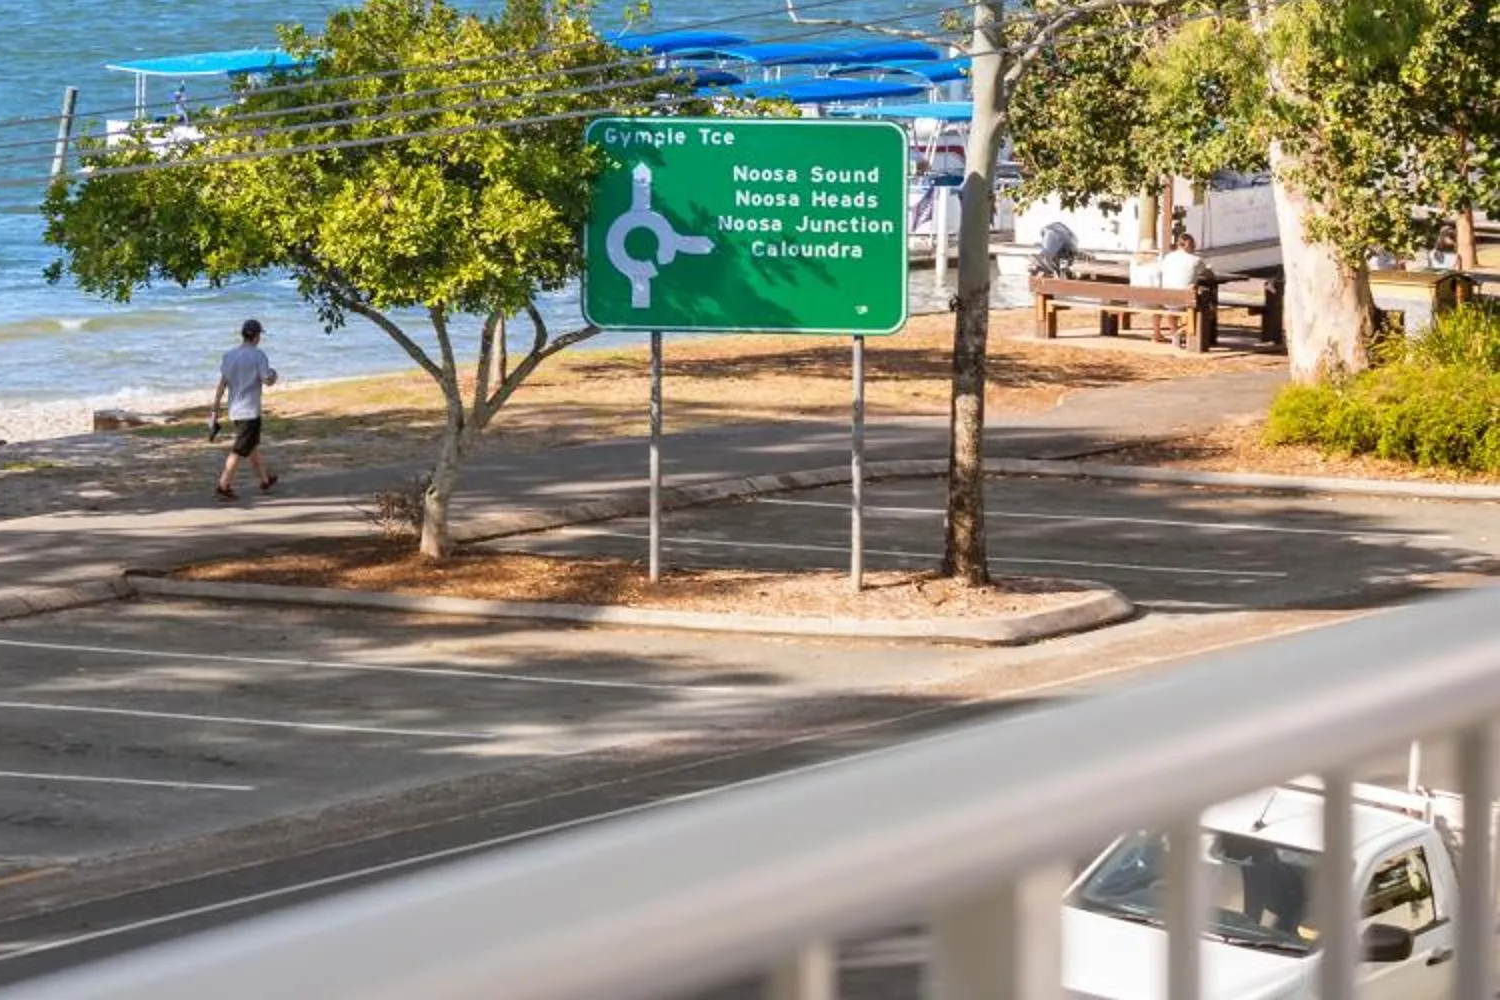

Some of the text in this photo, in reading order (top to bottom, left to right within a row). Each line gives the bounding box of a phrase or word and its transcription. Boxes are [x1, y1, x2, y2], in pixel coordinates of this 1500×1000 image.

[698, 127, 736, 145] Tce
[732, 165, 880, 184] Noosa Sound
[735, 190, 879, 209] Noosa Heads
[717, 215, 894, 234] Noosa Junction
[751, 240, 864, 259] Caloundra
